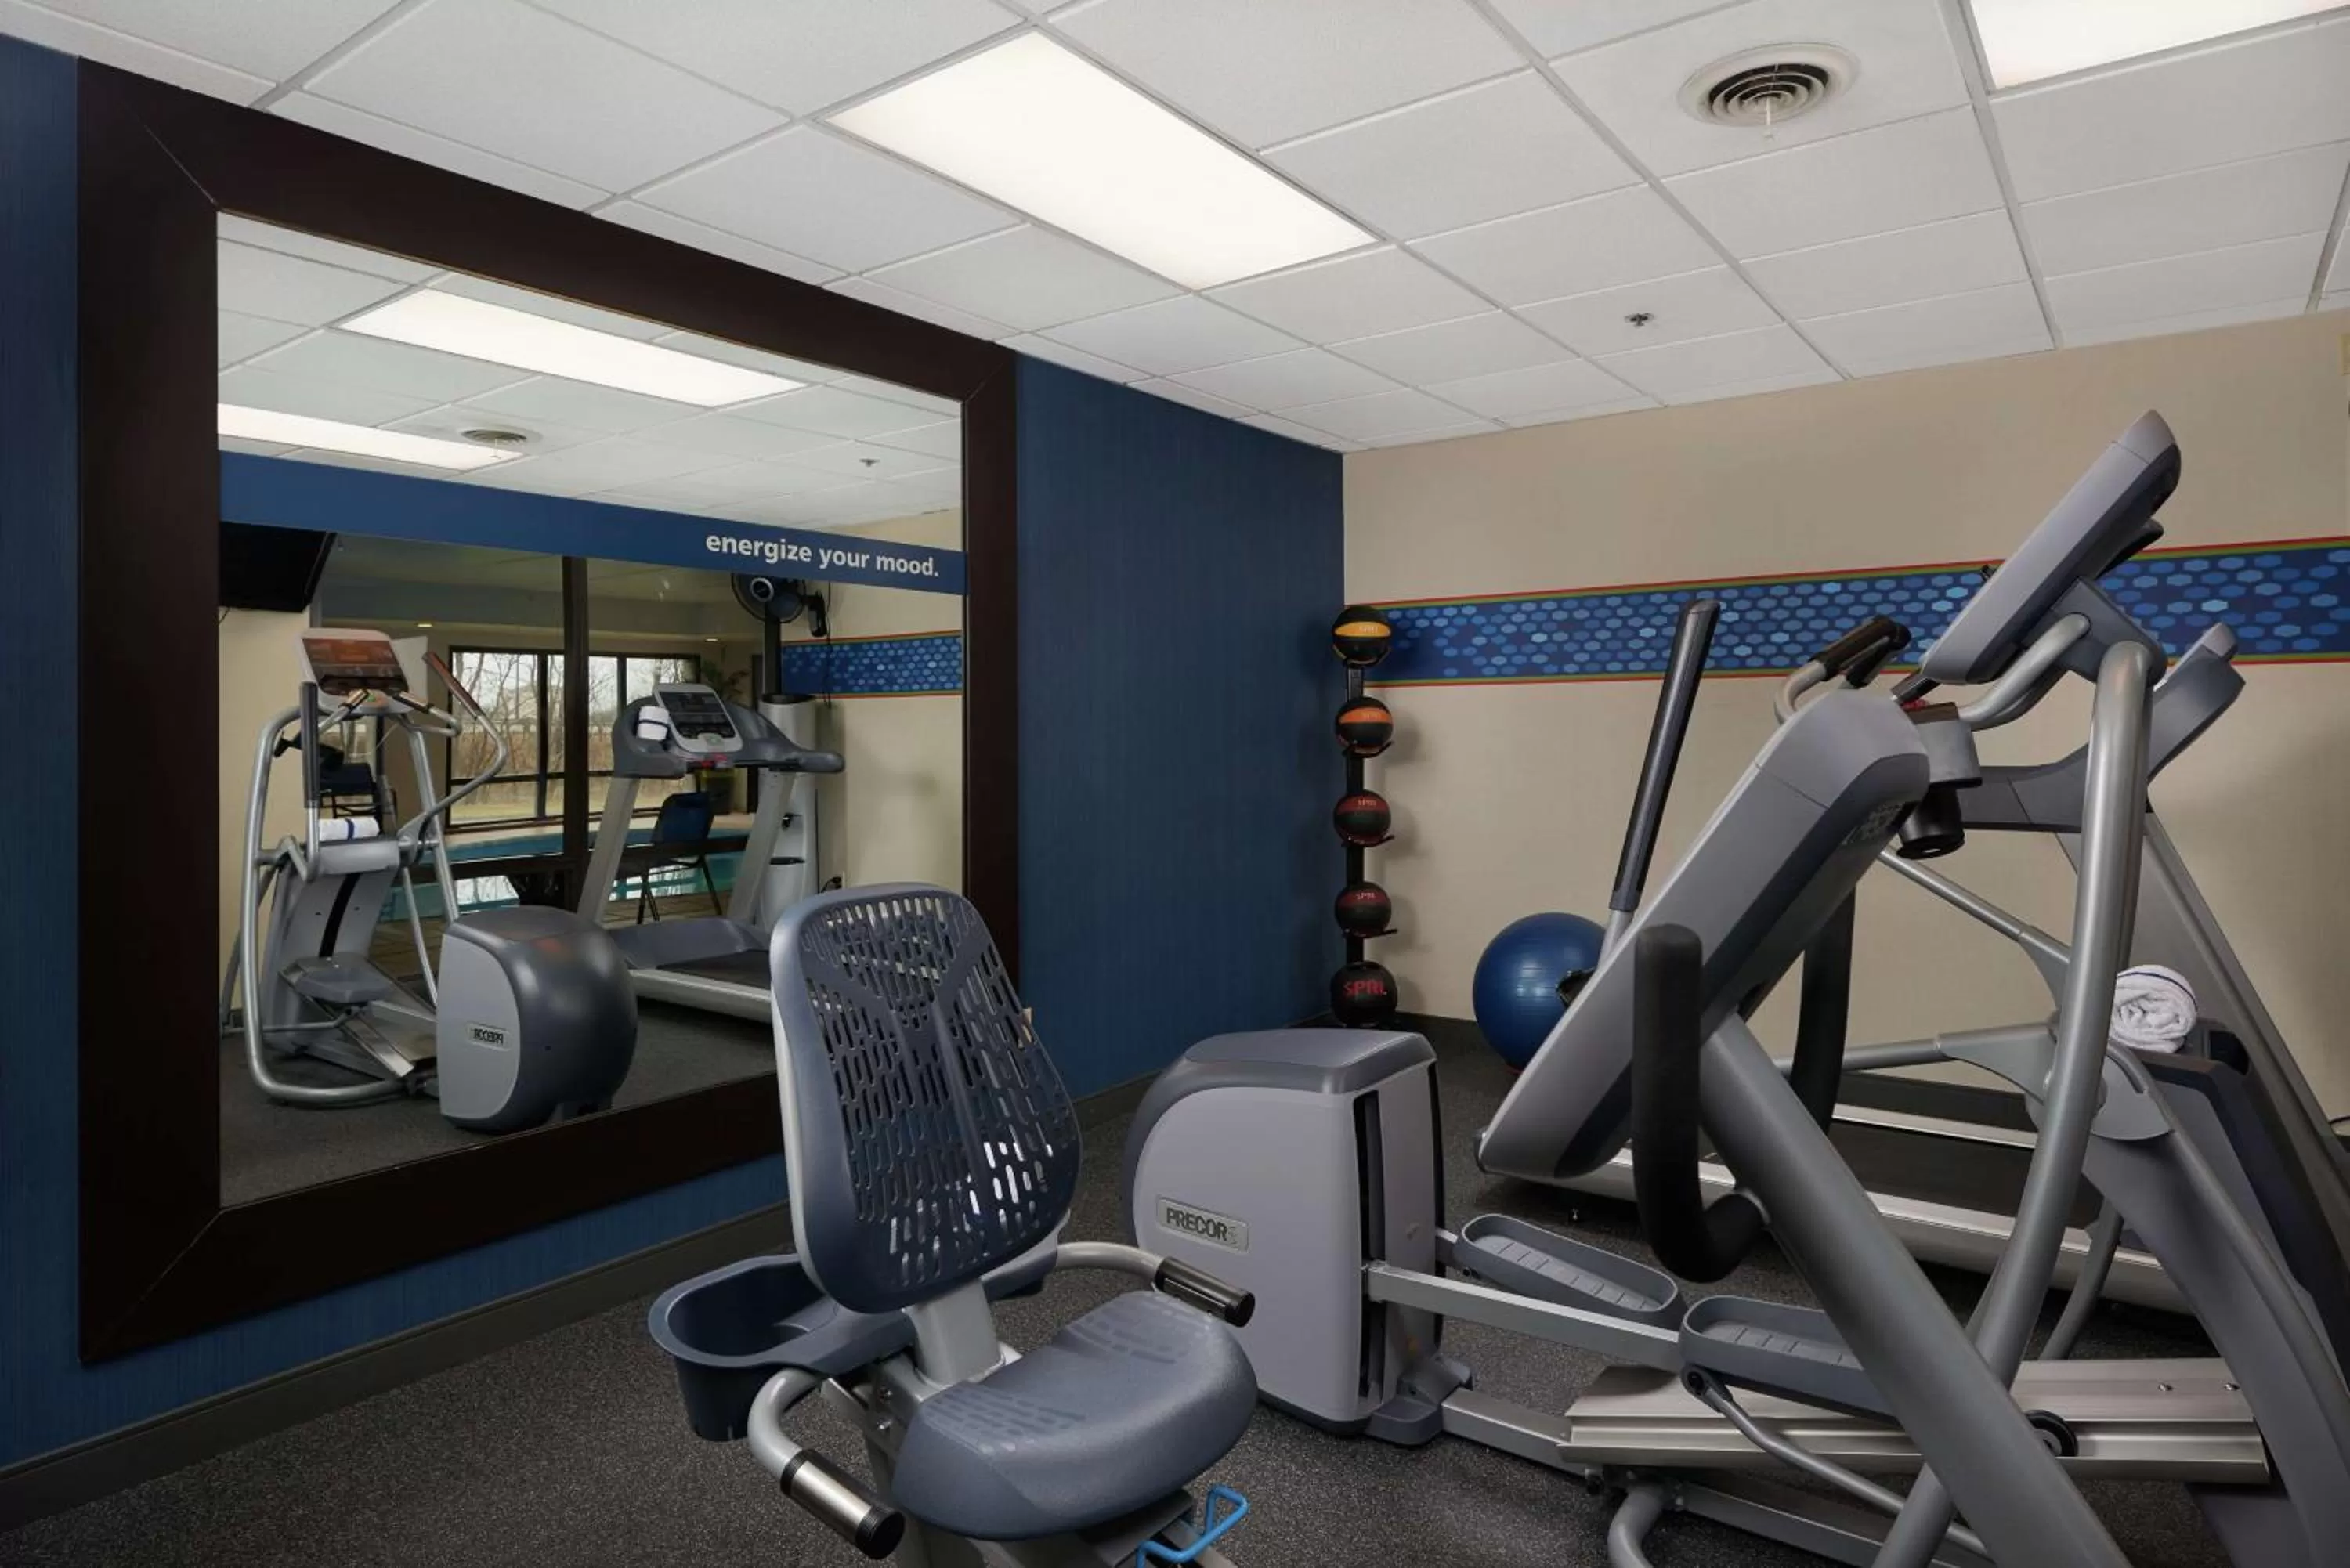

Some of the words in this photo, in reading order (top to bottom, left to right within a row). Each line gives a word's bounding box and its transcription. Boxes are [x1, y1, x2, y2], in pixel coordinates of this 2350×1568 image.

[706, 534, 812, 563] energize
[819, 547, 870, 569] your
[877, 555, 939, 577] mood.
[1166, 1207, 1227, 1241] PRECOR
